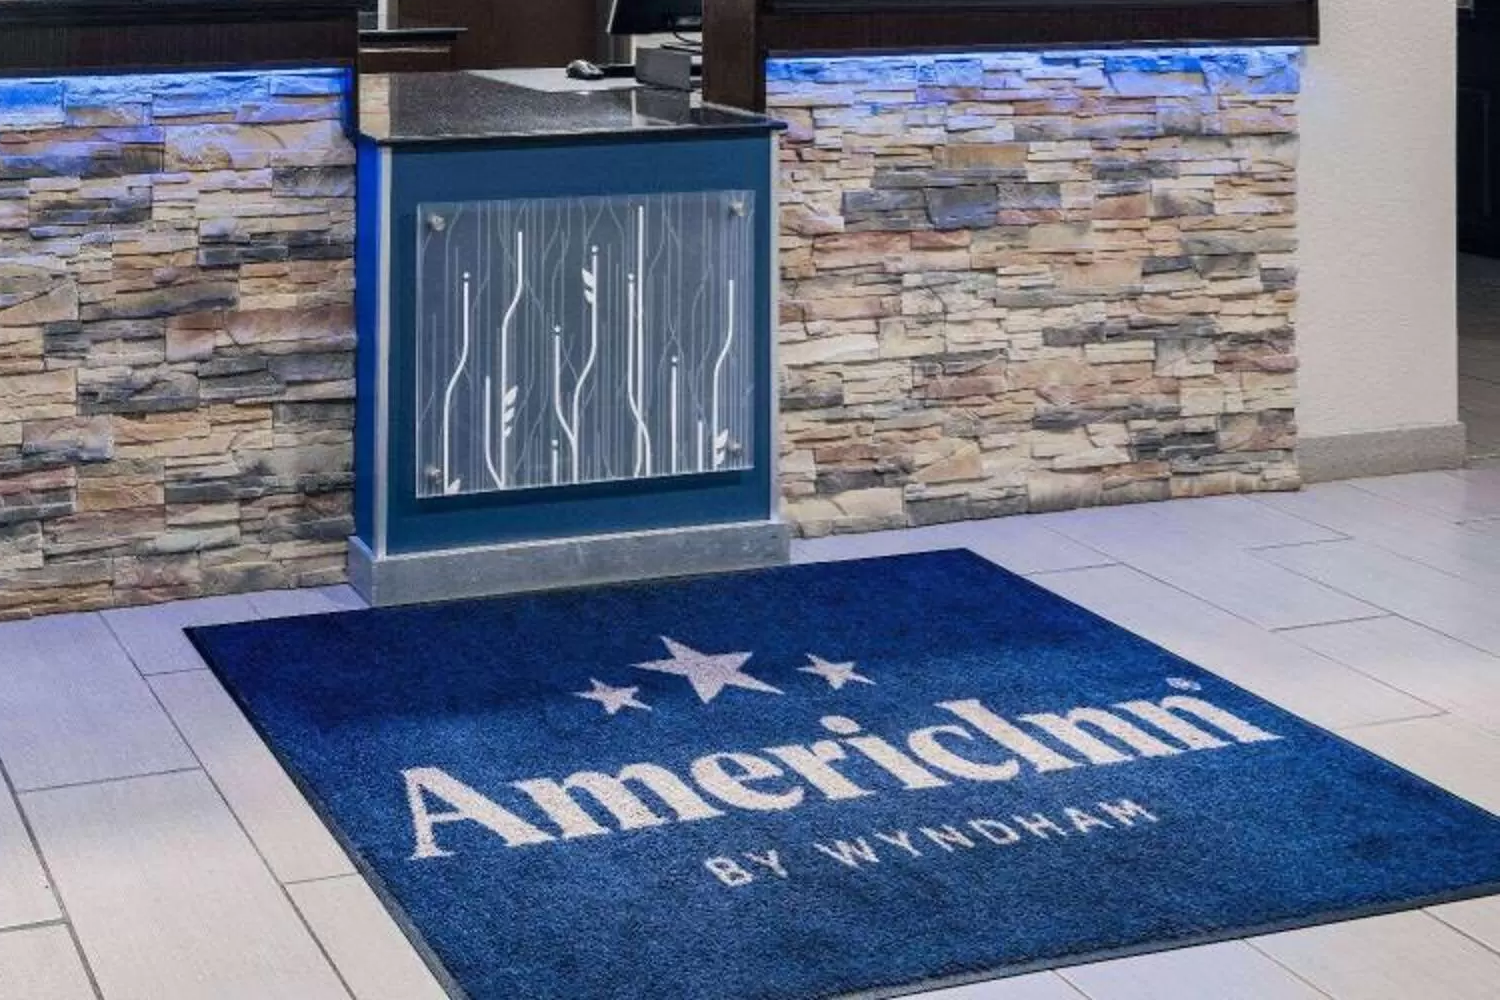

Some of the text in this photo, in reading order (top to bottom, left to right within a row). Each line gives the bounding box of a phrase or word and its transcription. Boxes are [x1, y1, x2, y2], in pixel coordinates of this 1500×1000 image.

[399, 694, 1285, 861] AmericInn
[704, 799, 1160, 888] BY WYNDHAM
